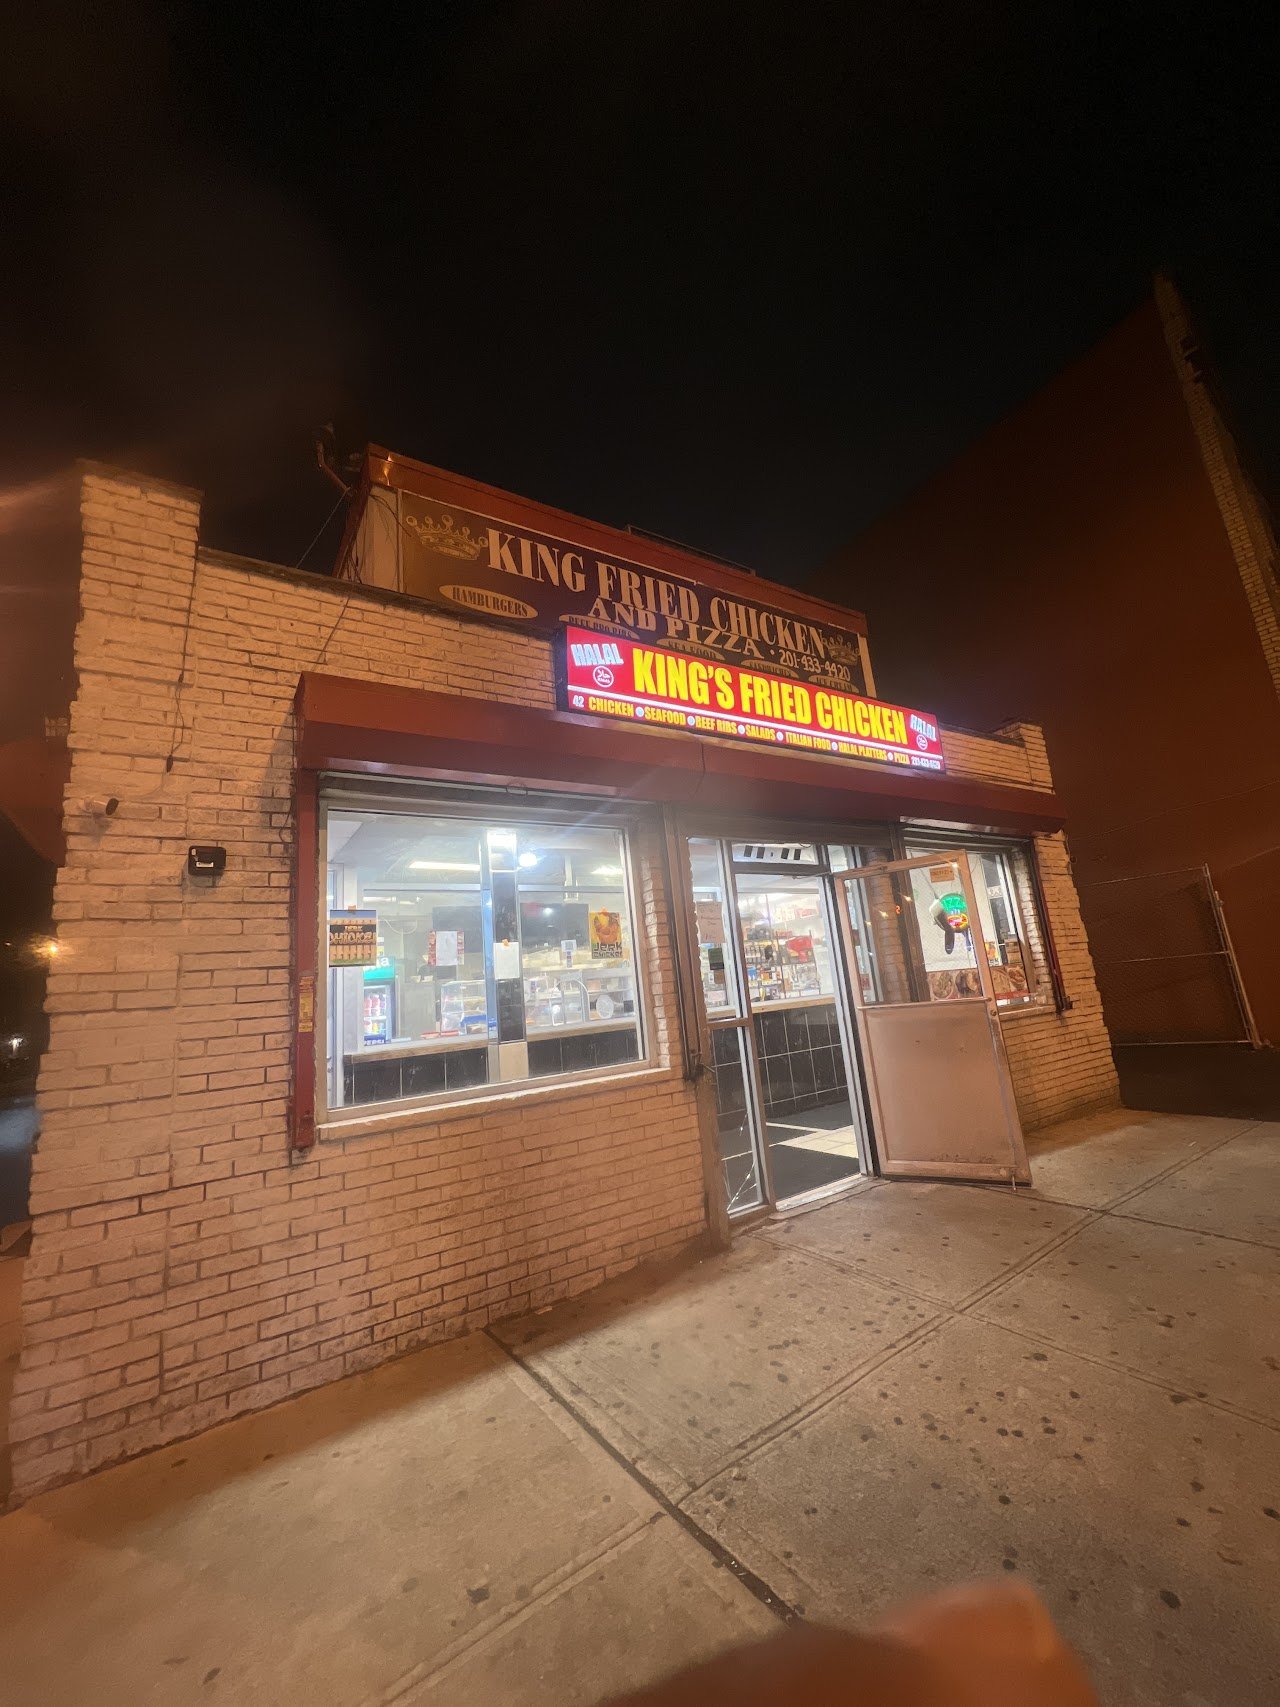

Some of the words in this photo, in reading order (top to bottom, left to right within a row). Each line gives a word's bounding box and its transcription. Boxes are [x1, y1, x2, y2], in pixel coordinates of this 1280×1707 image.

[452, 586, 530, 617] HAMBURGERS
[485, 527, 586, 593] KING
[596, 560, 700, 624] FRIED
[710, 597, 825, 660] CHICKEN
[588, 598, 657, 632] AND
[665, 616, 765, 660] PIZZA
[570, 643, 625, 667] HALAL
[779, 650, 851, 681] 201-433-4420
[633, 647, 735, 711] KING'S
[739, 673, 813, 725] FRIED
[815, 691, 908, 745] CHICKEN
[588, 696, 634, 717] CHICKEN
[644, 706, 686, 726] SEAFOOD
[695, 715, 716, 731] BEEF
[717, 718, 738, 735] RIBS
[745, 724, 776, 741] SALADS
[785, 731, 813, 748] ITALIAN
[813, 736, 832, 751] FOOD
[838, 741, 858, 755] HALAL
[910, 713, 937, 742] HALAL
